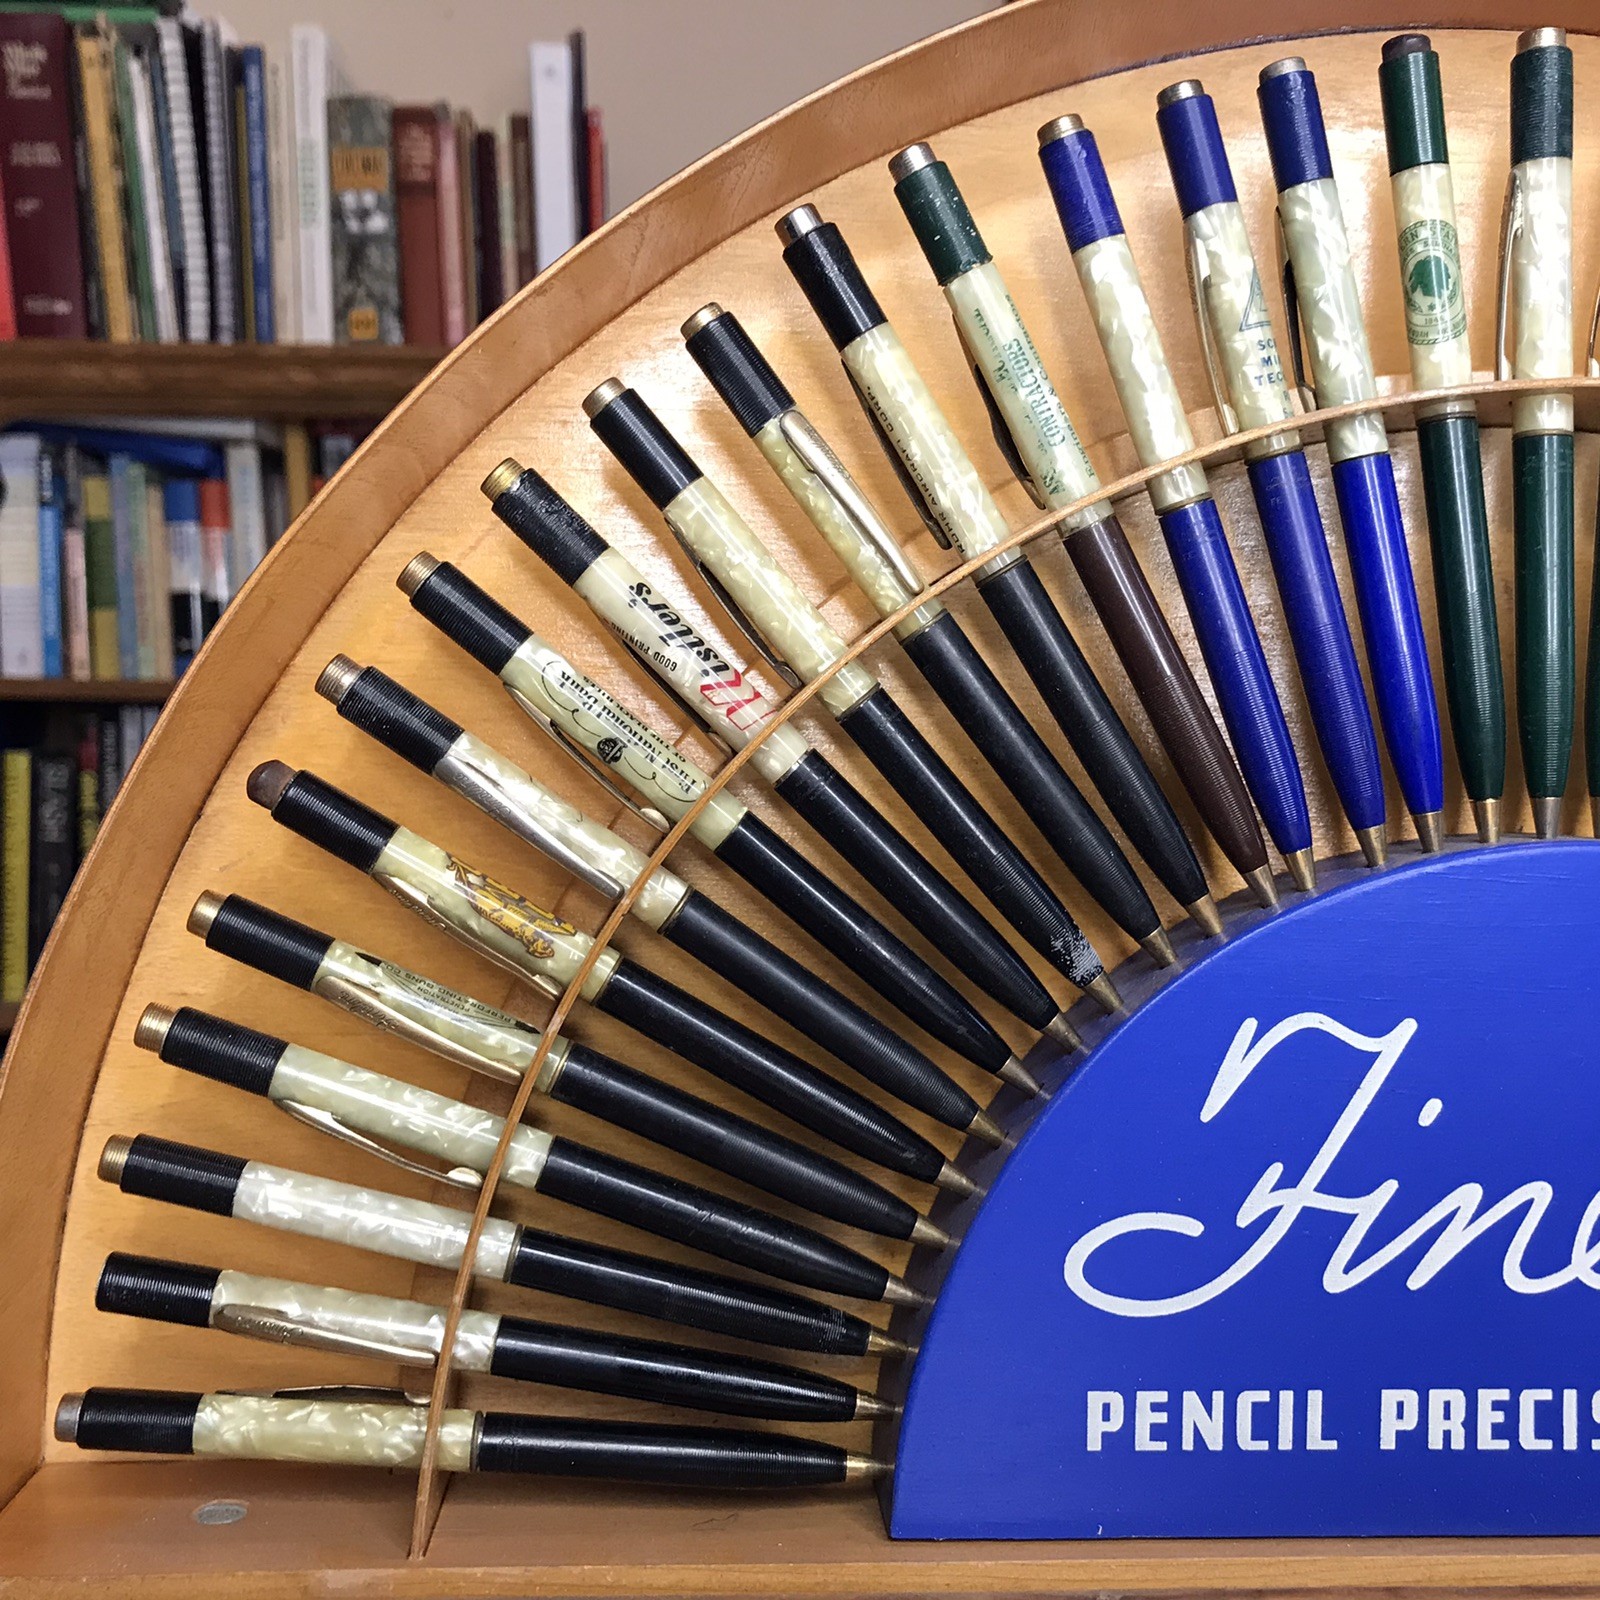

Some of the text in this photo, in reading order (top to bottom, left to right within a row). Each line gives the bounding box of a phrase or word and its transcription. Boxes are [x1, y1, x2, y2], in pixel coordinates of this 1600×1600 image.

[999, 336, 1067, 449] CONTRACTORS
[936, 510, 966, 554] ROHR
[651, 649, 678, 672] GOOD
[552, 669, 599, 713] Bank
[593, 704, 662, 765] National
[657, 756, 698, 795] First
[415, 984, 471, 1013] PENETRATION
[1087, 1388, 1600, 1450] PENCIL PRECI
